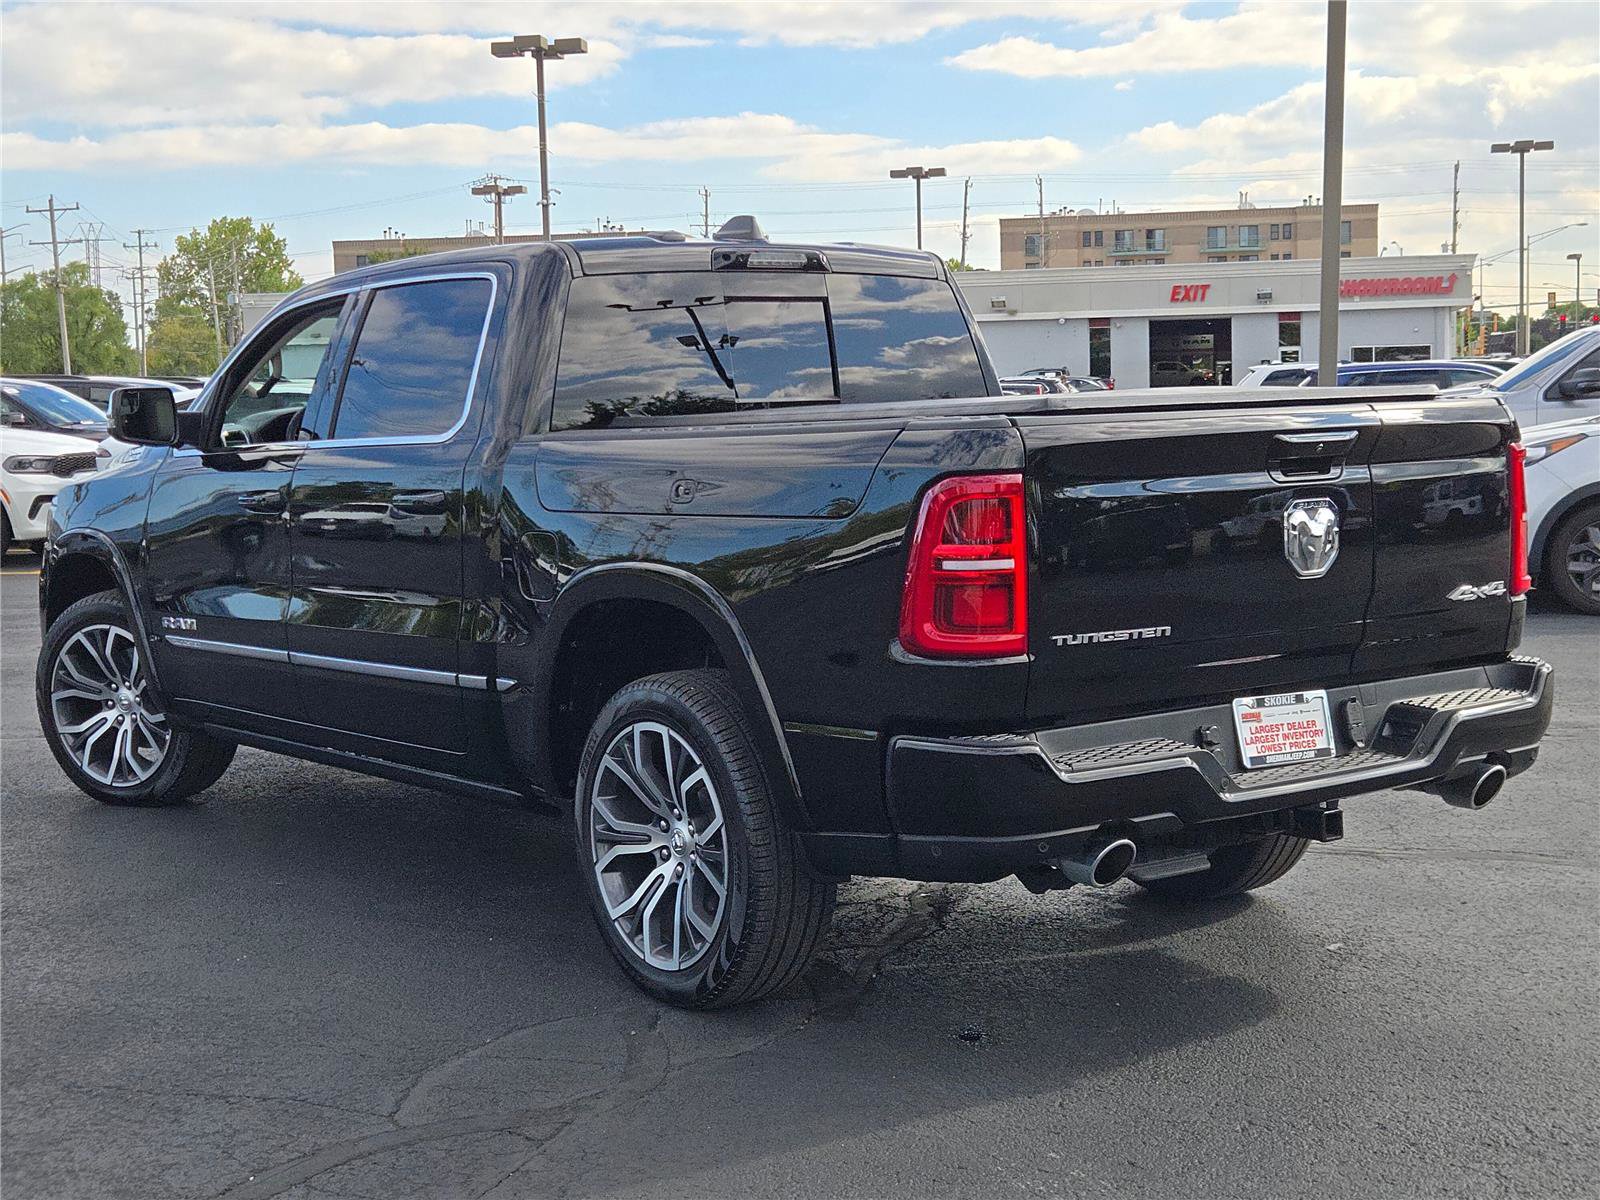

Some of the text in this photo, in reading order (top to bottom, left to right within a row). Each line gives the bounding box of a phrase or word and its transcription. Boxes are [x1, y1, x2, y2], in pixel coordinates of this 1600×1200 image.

[1170, 284, 1211, 302] EXIT
[161, 616, 197, 630] RAM
[1051, 626, 1172, 646] TUNGSTEN
[1264, 694, 1297, 707] SKOKIE
[1249, 719, 1318, 736] LARGEST DEALER
[1244, 728, 1325, 746] LARGEST INVENTORY
[1256, 738, 1318, 755] LOWEST PRICES
